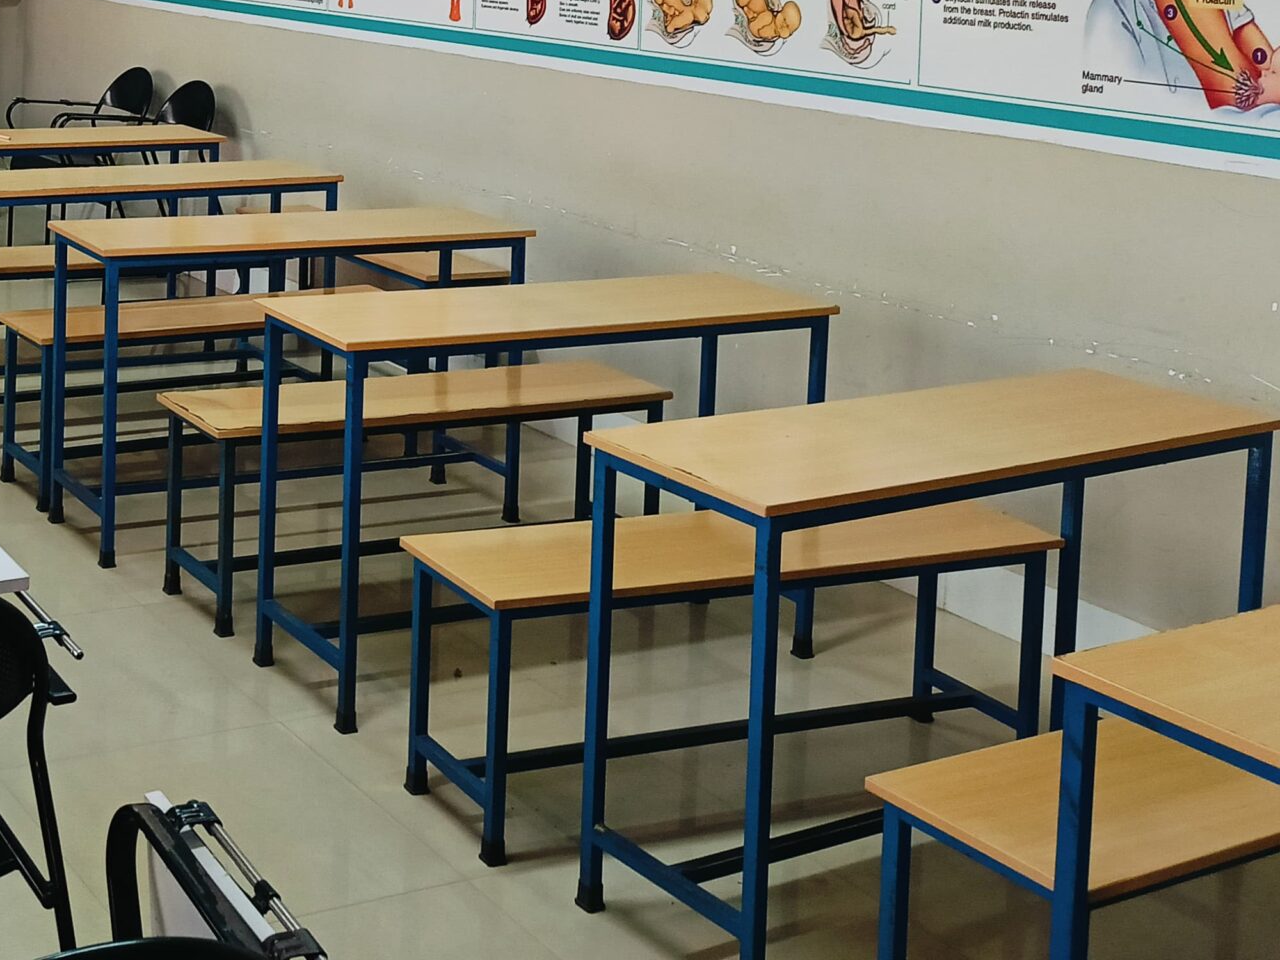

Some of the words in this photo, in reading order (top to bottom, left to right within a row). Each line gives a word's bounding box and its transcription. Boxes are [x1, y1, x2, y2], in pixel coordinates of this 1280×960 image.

[1029, 0, 1056, 10] release
[943, 5, 959, 13] from
[961, 6, 971, 14] the
[998, 9, 1029, 19] Prolactin
[1031, 13, 1069, 22] stimulates
[1168, 8, 1173, 17] 3
[943, 17, 976, 26] additional
[978, 19, 992, 28] milk
[993, 21, 1033, 31] production.
[1257, 52, 1261, 60] 1
[1082, 71, 1122, 84] Mammary
[1081, 83, 1104, 94] gland
